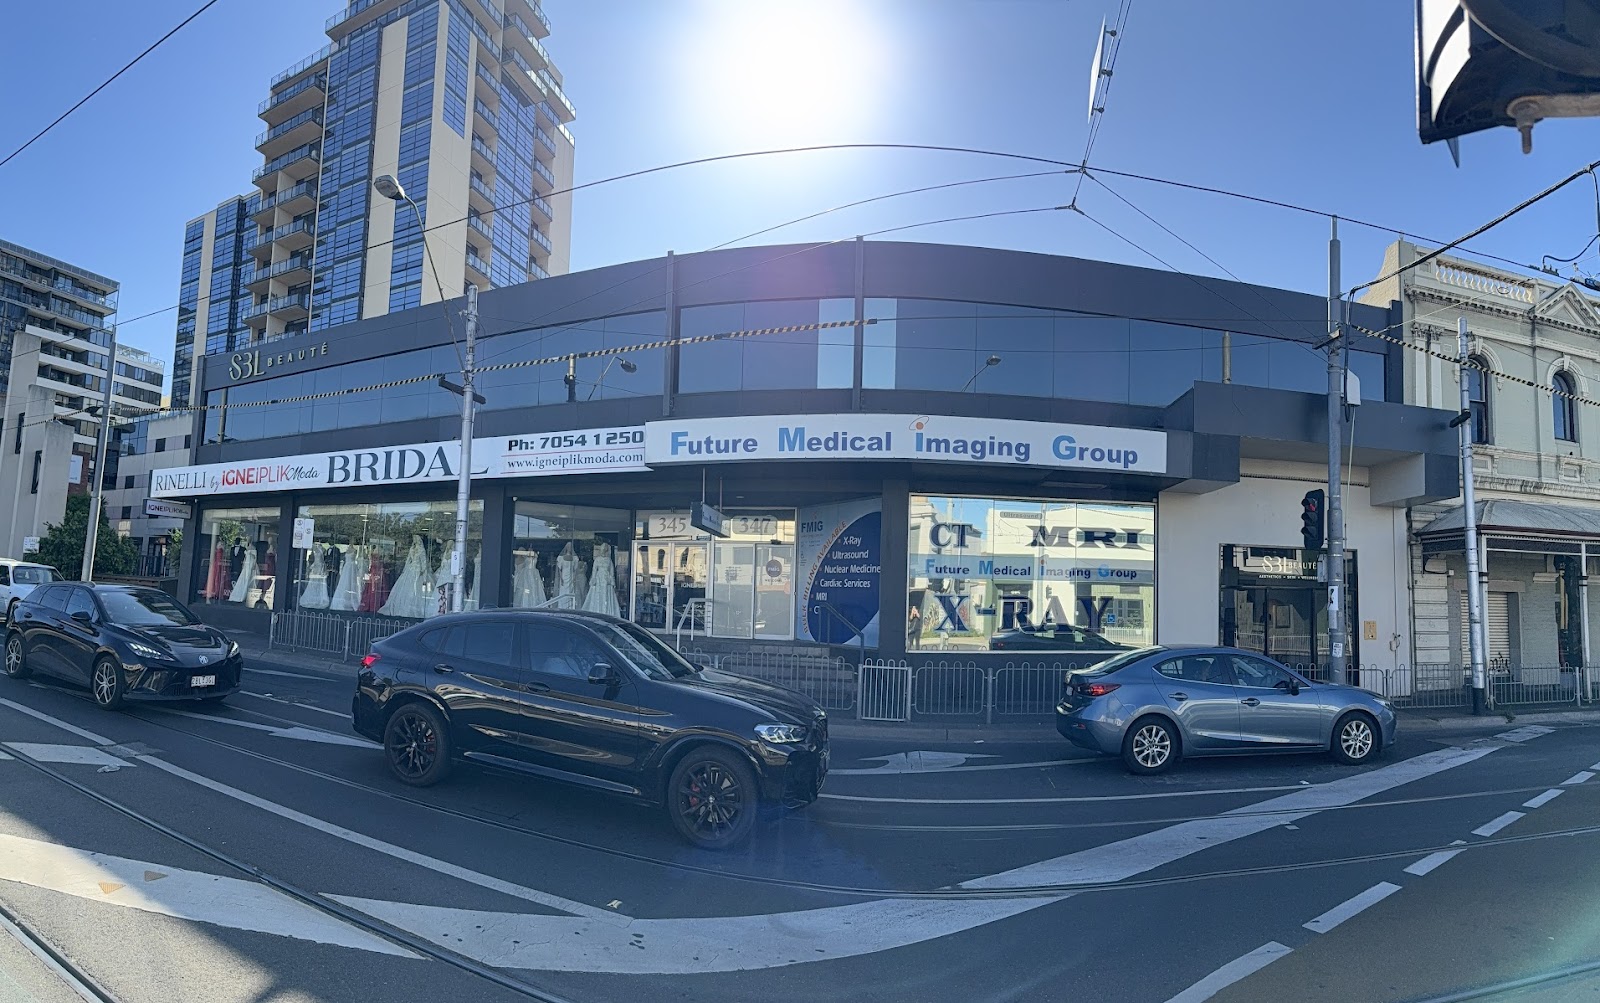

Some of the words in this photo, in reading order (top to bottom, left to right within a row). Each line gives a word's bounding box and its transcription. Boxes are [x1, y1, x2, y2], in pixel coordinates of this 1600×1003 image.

[267, 342, 328, 367] BEAUTÉ
[508, 439, 535, 451] Ph:
[539, 434, 588, 449] 7054
[670, 431, 759, 455] Future
[778, 426, 892, 452] Medical
[1052, 435, 1138, 468] Group
[507, 452, 643, 469] www.igneiplikmoda.com
[155, 471, 207, 491] RINELLI
[658, 516, 687, 533] 345
[739, 517, 772, 533] 347
[801, 520, 824, 533] FMIG
[817, 521, 847, 562] AVAILABLE
[842, 536, 862, 547] X-Ray
[929, 521, 974, 548] CT
[1024, 525, 1147, 550] MRI
[832, 550, 869, 560] Ultrasound
[824, 564, 849, 574] Nuclear
[849, 564, 881, 574] Medicine
[926, 558, 970, 574] Future
[978, 560, 1031, 576] Medical
[1098, 564, 1137, 579] Group
[820, 579, 843, 588] Cardiac
[843, 578, 871, 588] Services
[815, 592, 828, 601] MRI
[934, 593, 1114, 634] X-RAY
